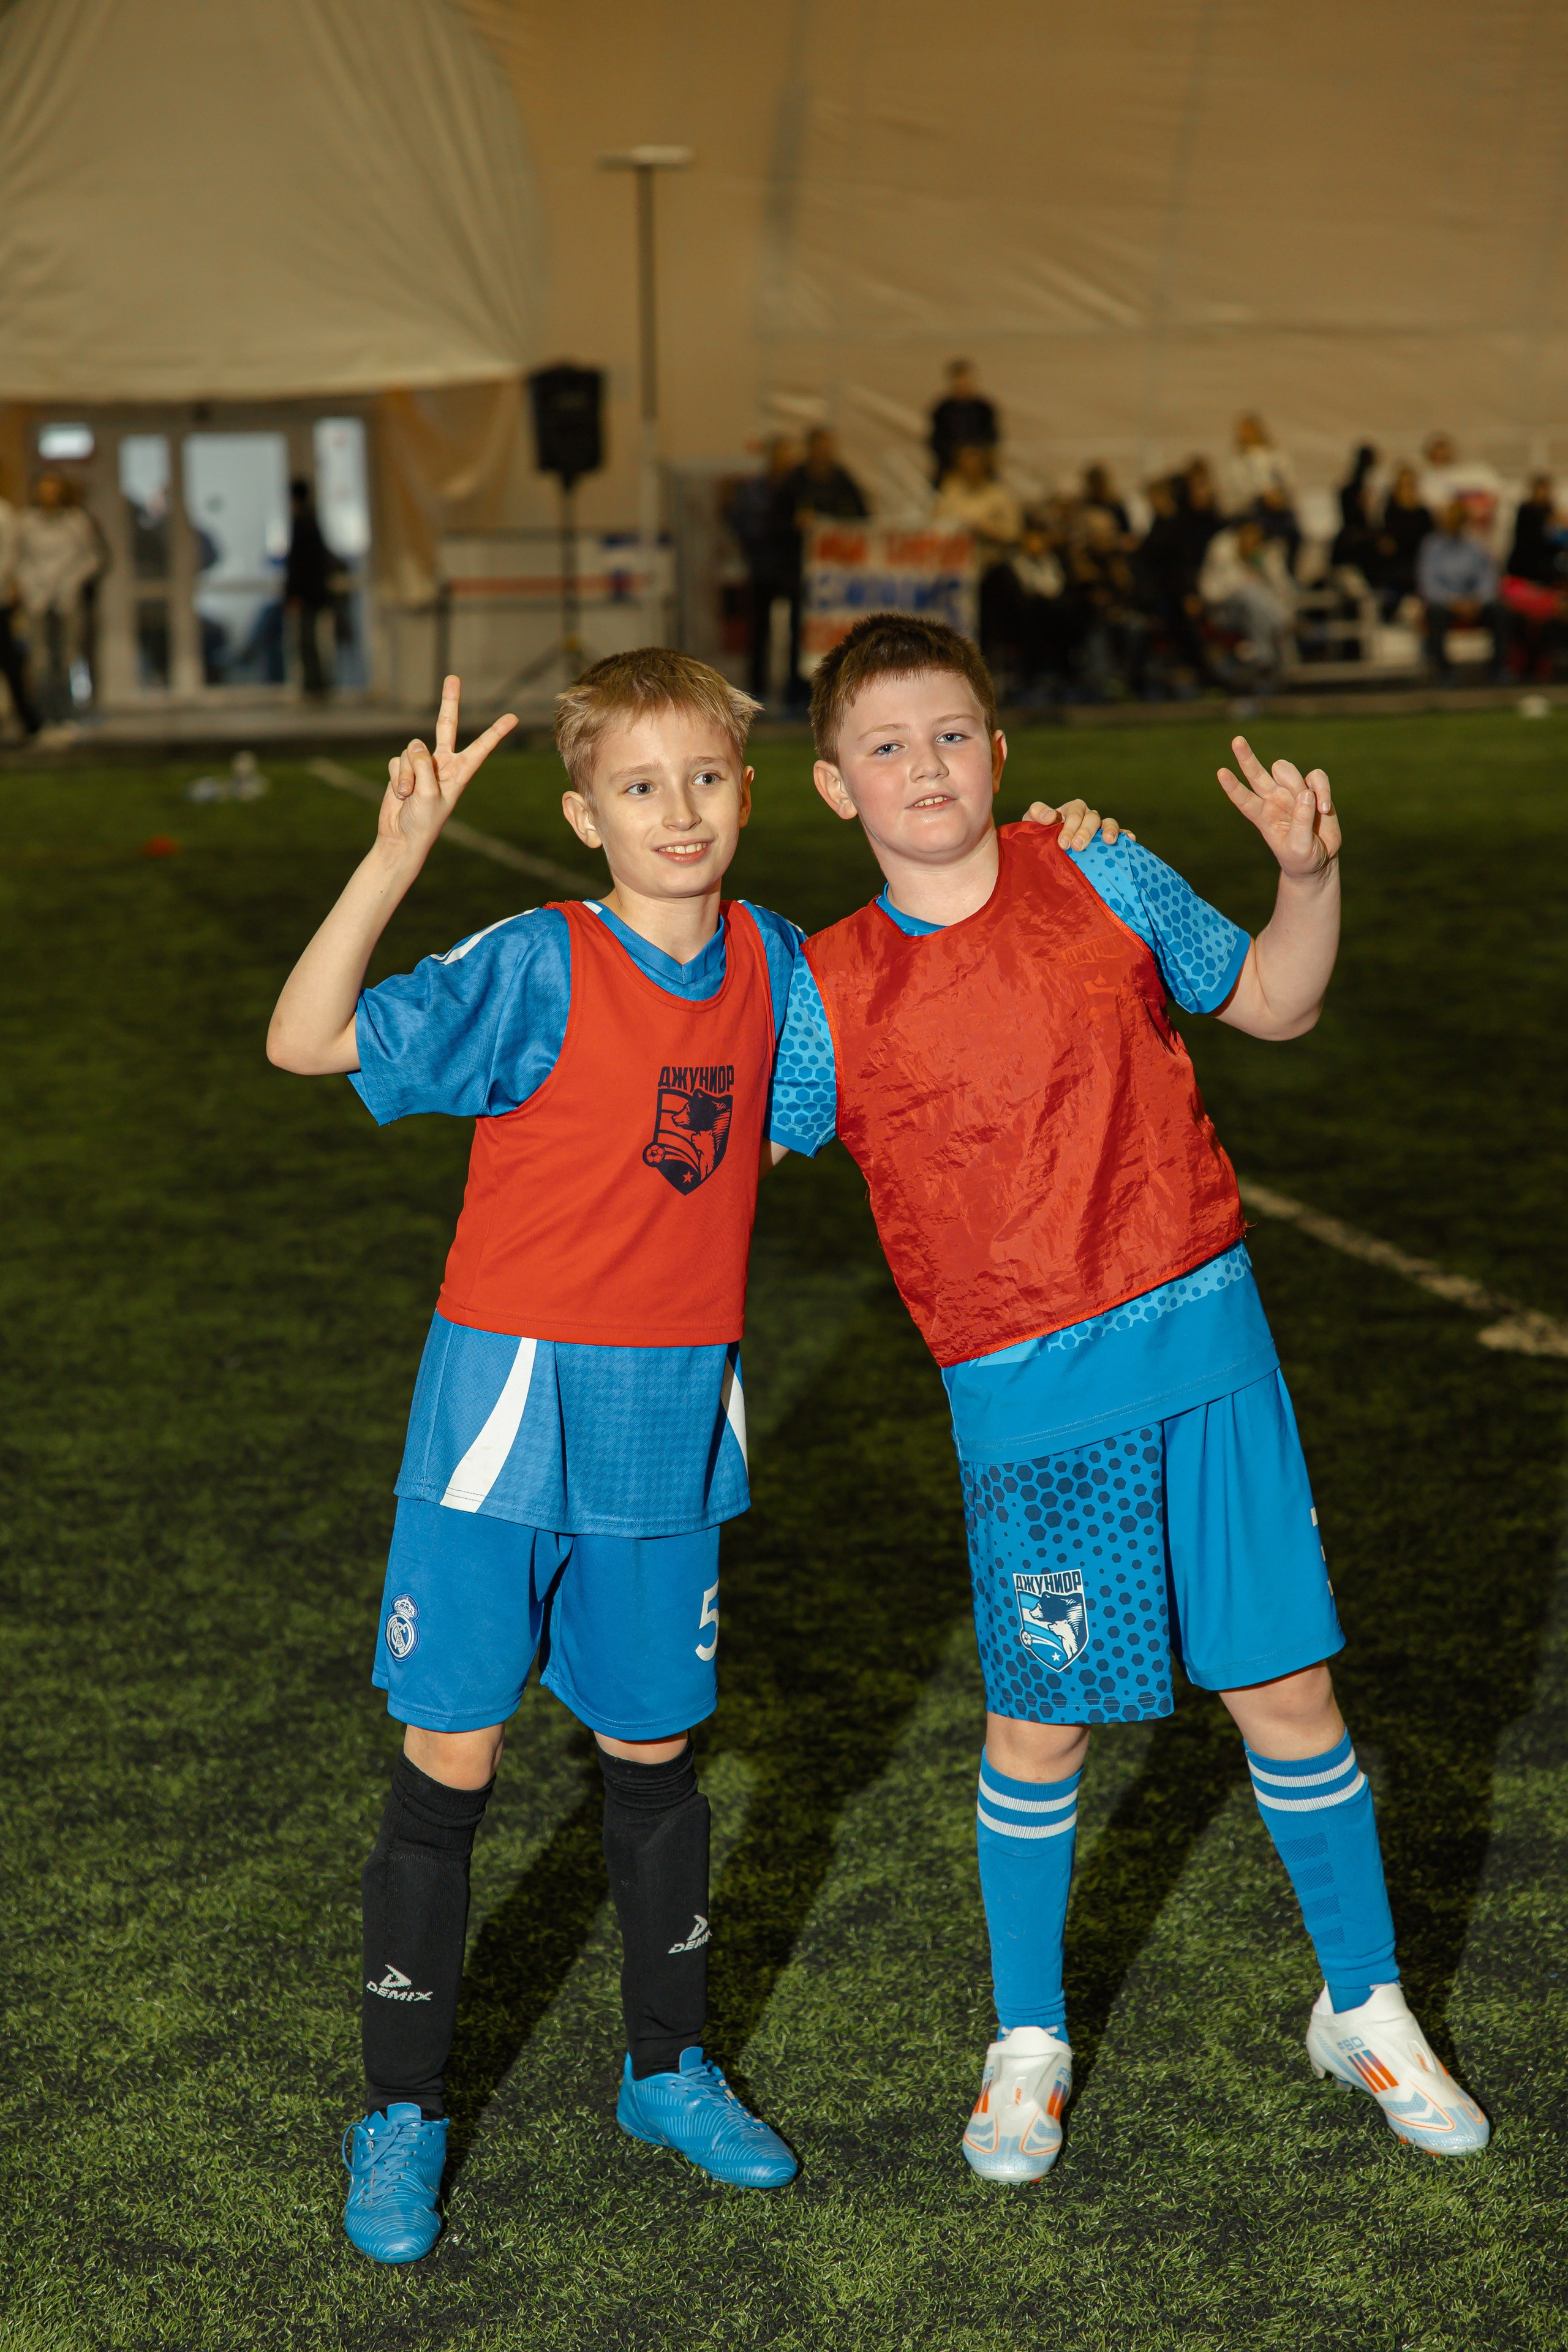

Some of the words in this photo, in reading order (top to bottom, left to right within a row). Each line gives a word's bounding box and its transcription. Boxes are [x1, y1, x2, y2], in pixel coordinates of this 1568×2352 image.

[658, 1065, 734, 1095] ДЖУНИОР
[1016, 1570, 1082, 1595] ДЖУНИОР
[695, 1577, 720, 1661] 5
[366, 1980, 433, 2002] DEMIX
